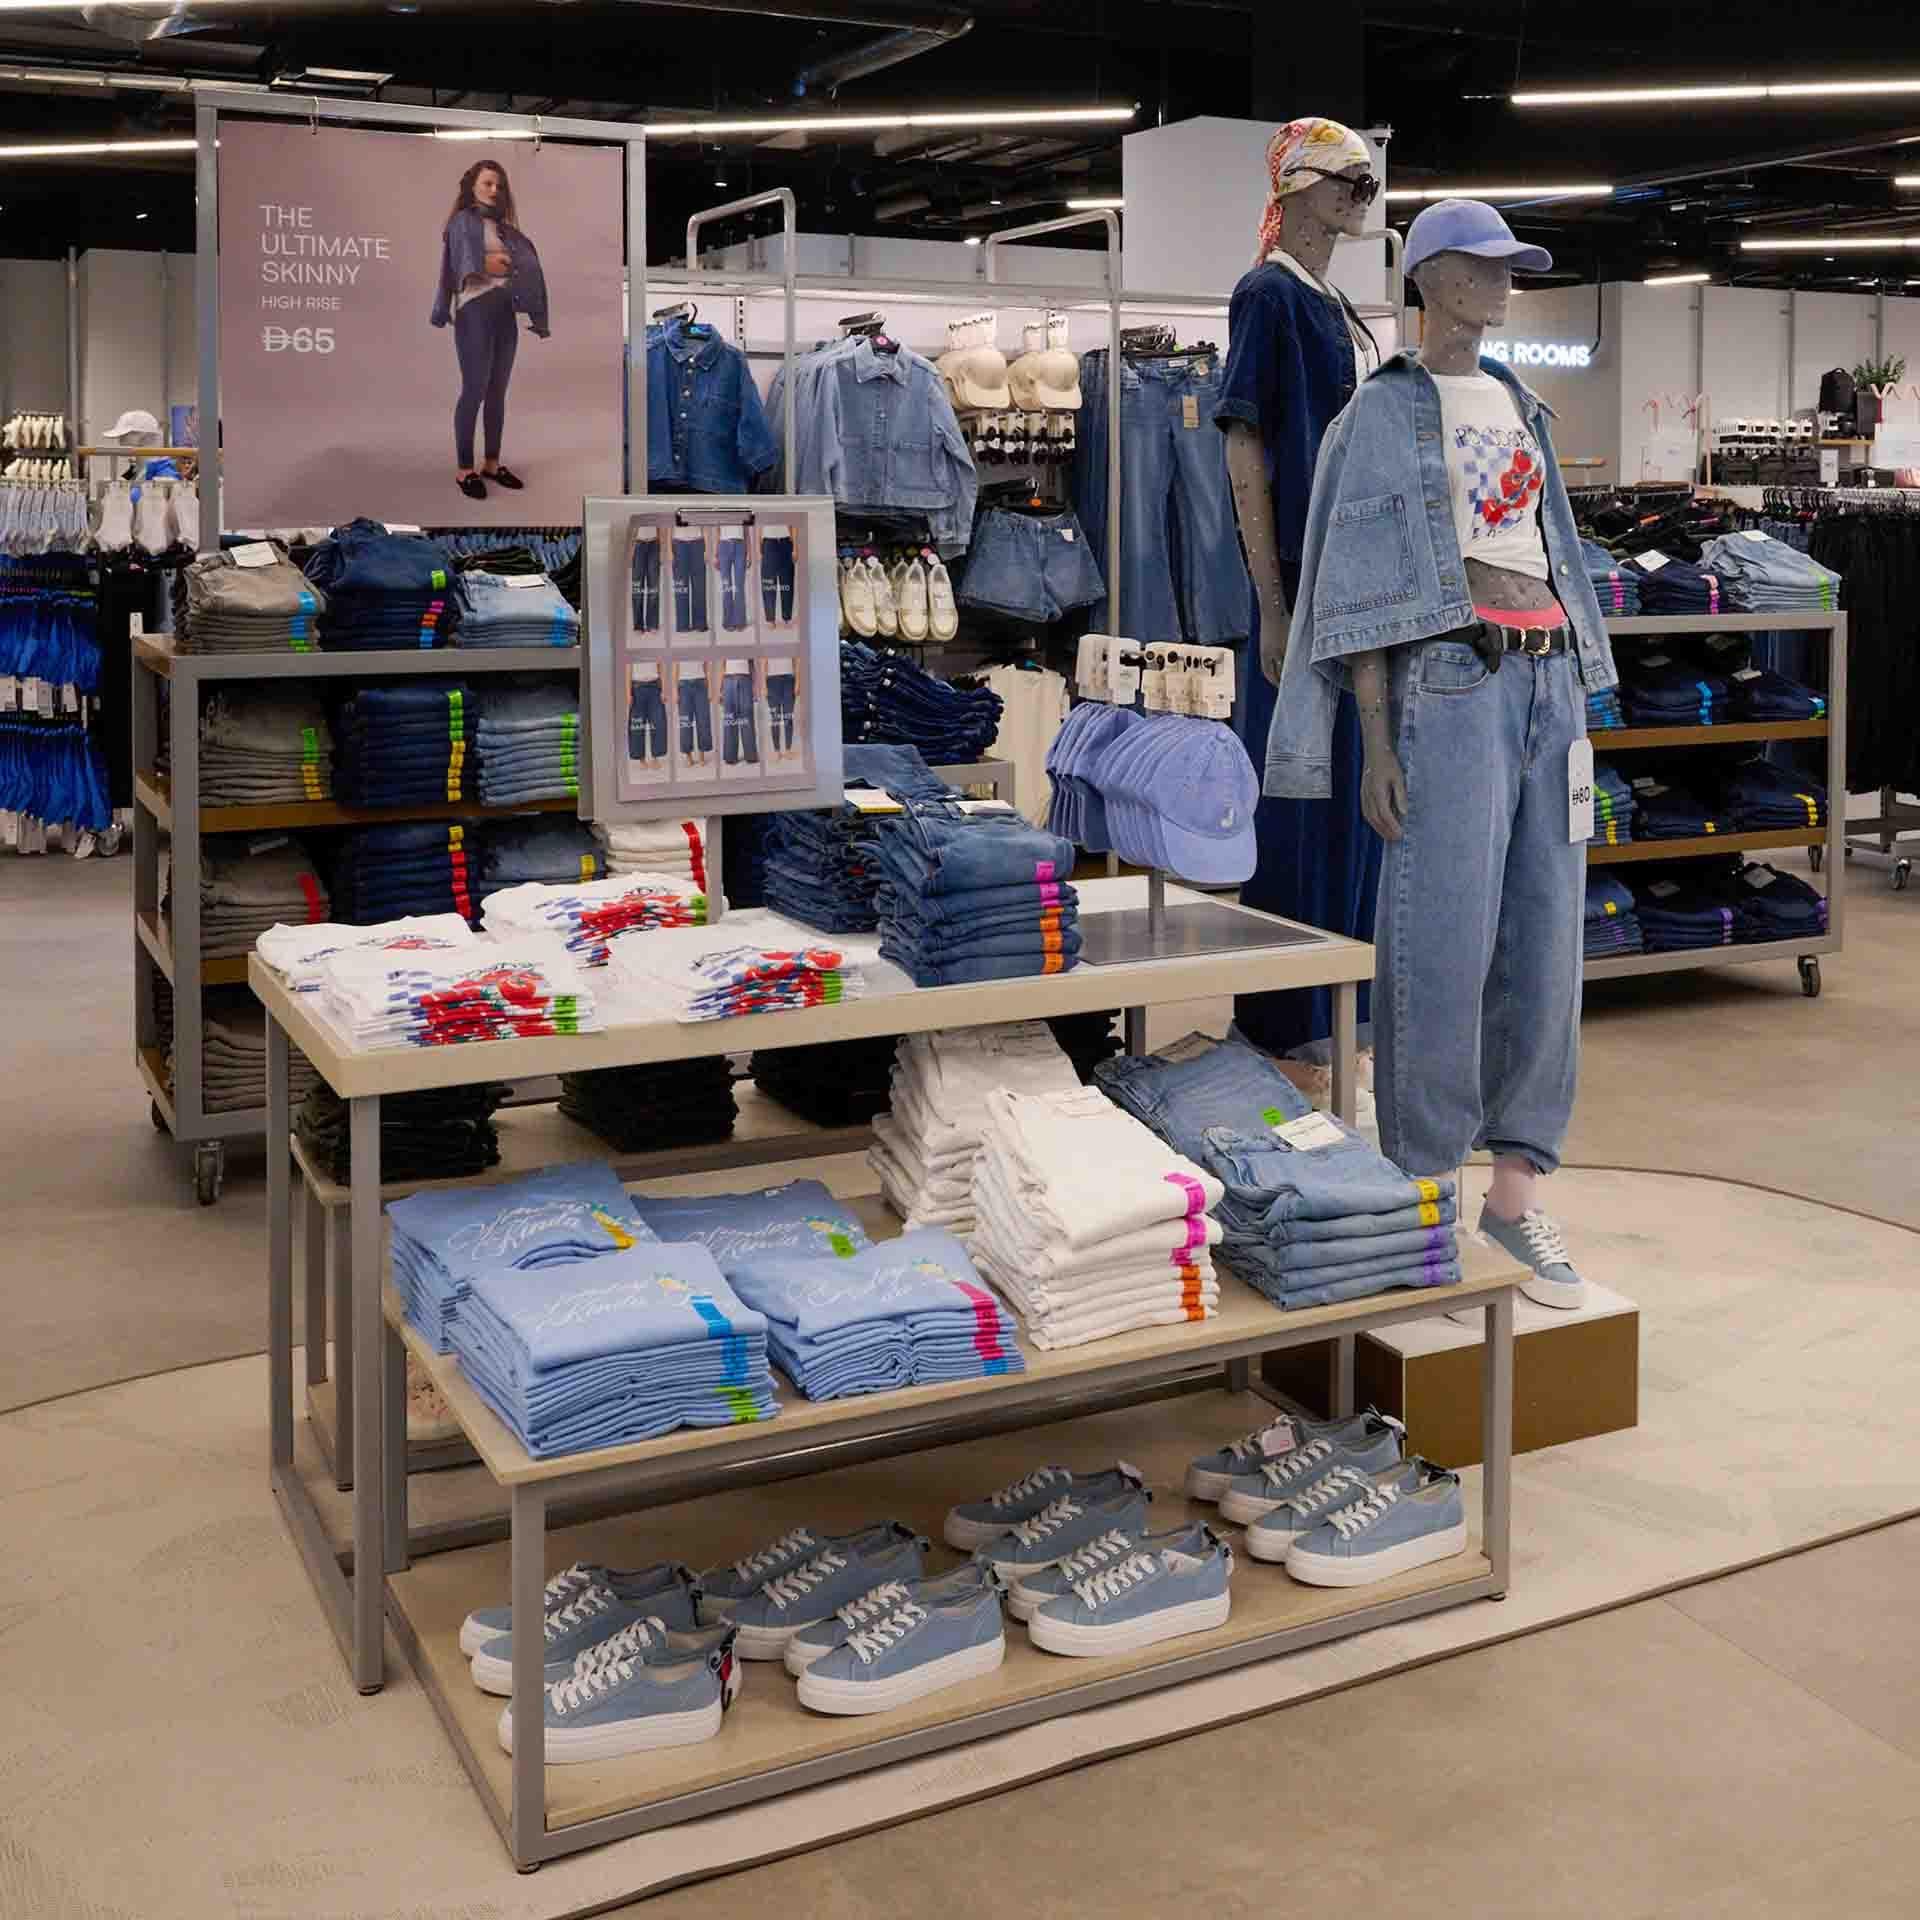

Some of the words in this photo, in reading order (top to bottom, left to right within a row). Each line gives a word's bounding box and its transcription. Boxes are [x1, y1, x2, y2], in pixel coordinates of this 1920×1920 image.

[260, 205, 313, 228] THE
[261, 233, 391, 259] ULTIMATE
[261, 261, 361, 285] SKINNY
[261, 296, 301, 309] HIGH
[306, 297, 342, 310] RISE
[1513, 343, 1592, 367] ROOMS
